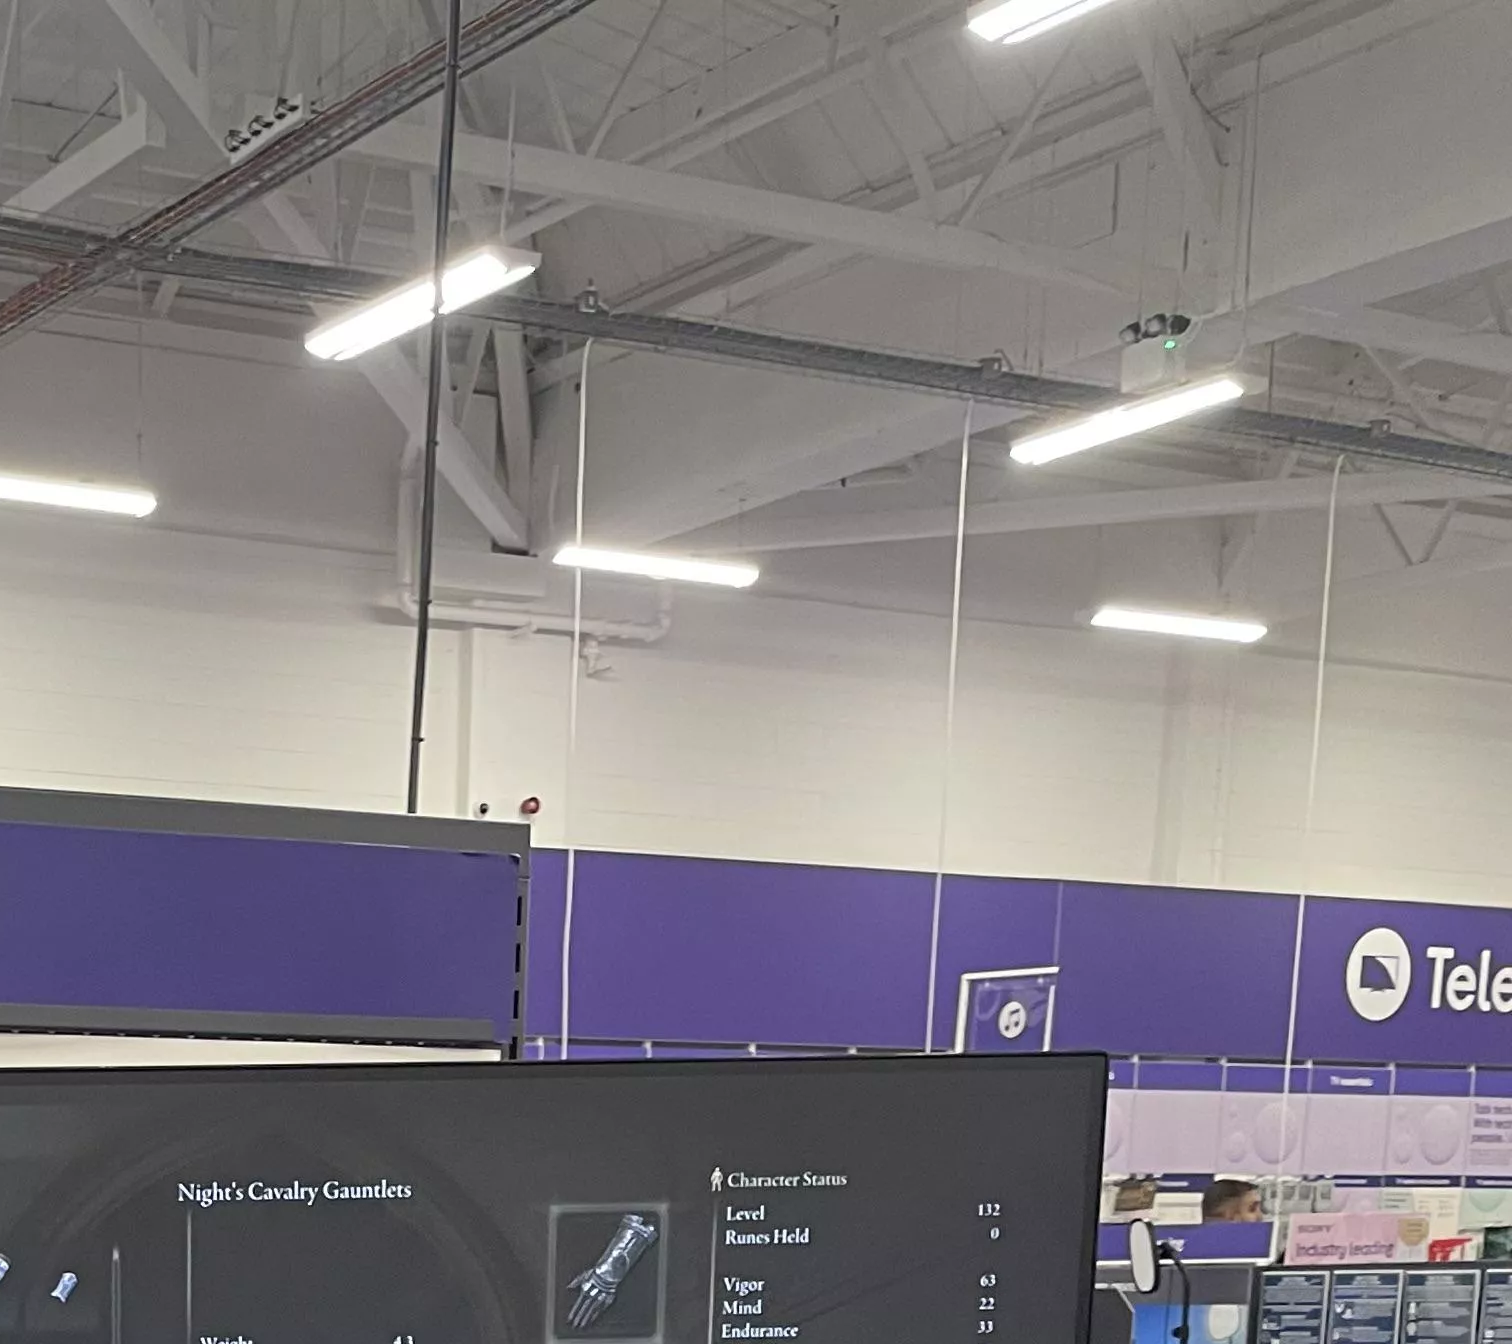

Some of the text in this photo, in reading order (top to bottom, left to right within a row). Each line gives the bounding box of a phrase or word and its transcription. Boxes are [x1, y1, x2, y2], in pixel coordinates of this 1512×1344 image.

[727, 1172, 848, 1188] Character Status
[177, 1180, 412, 1207] Night's Cavalry Gauntlets
[726, 1203, 1001, 1221] Level 132
[725, 1229, 770, 1245] Runes
[773, 1228, 810, 1244] Held
[724, 1274, 996, 1296] Vigor 63
[722, 1298, 995, 1315] Mind 22
[721, 1321, 993, 1339] Endurance 33
